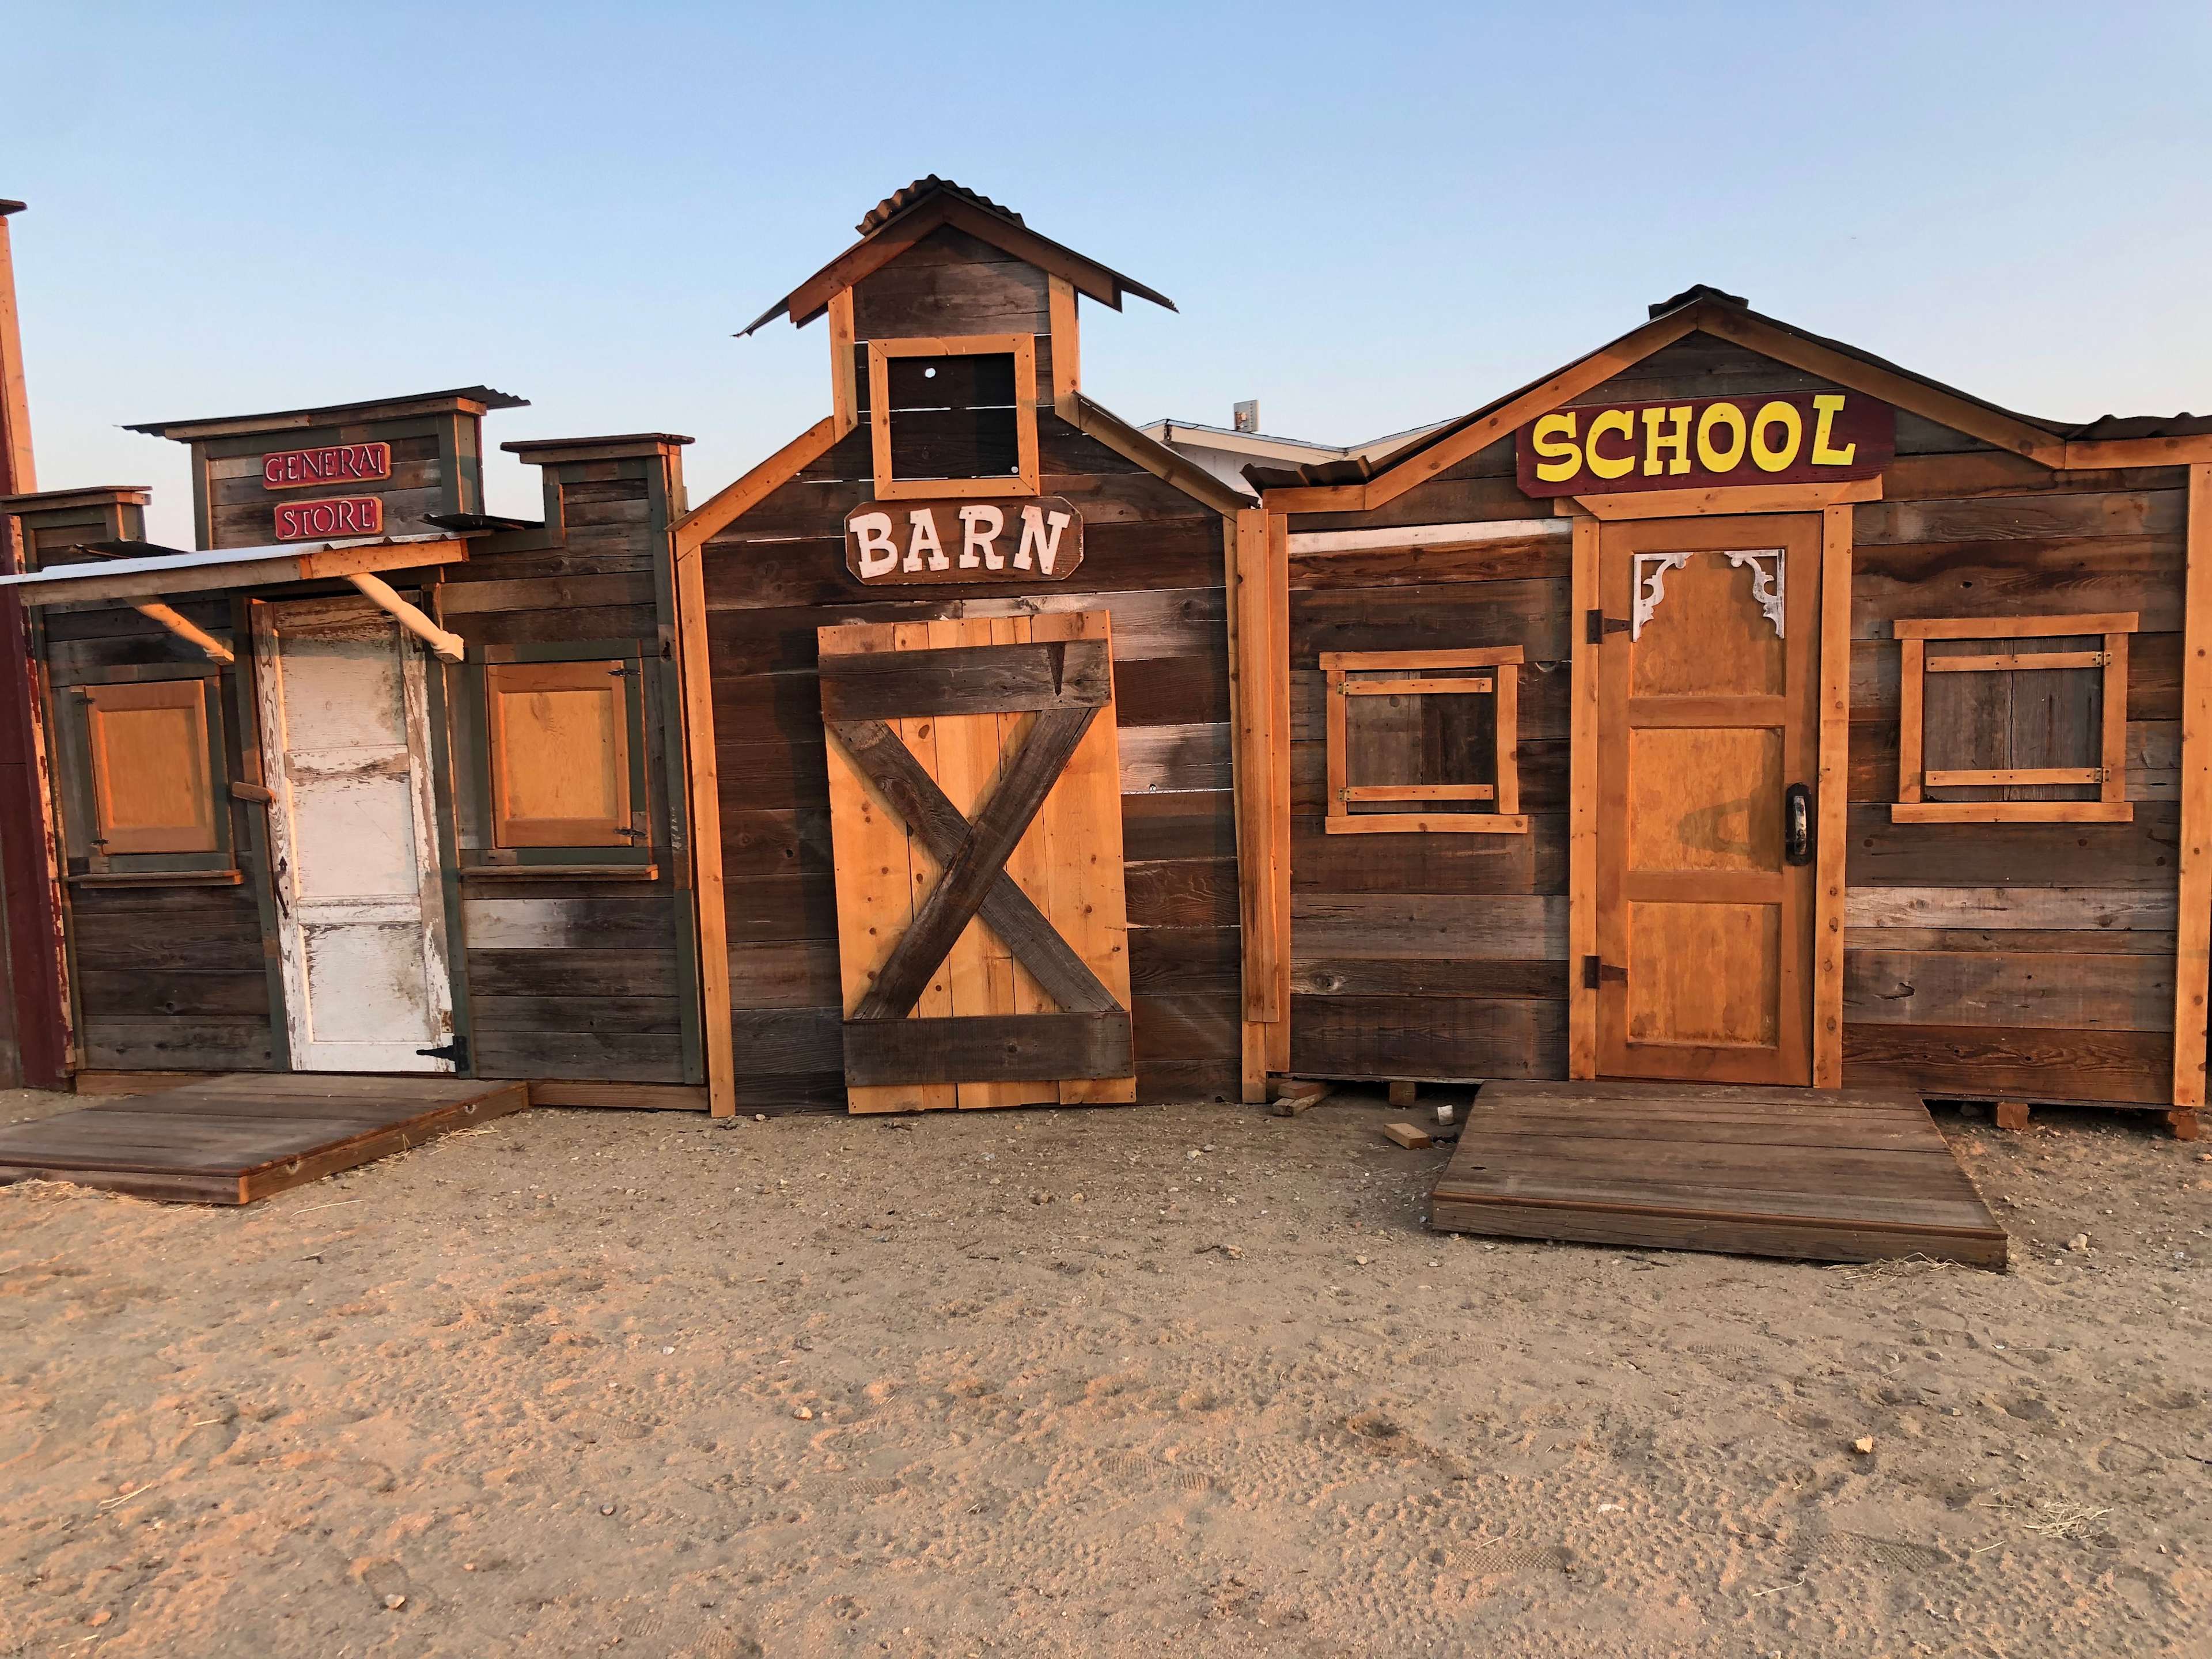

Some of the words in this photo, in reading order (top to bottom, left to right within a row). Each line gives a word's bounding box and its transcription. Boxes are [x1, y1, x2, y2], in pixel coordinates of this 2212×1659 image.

[265, 445, 384, 482] GENERAL
[1532, 395, 1856, 482] SCHOOL
[282, 500, 375, 538] STORE
[849, 505, 1071, 579] BARN
